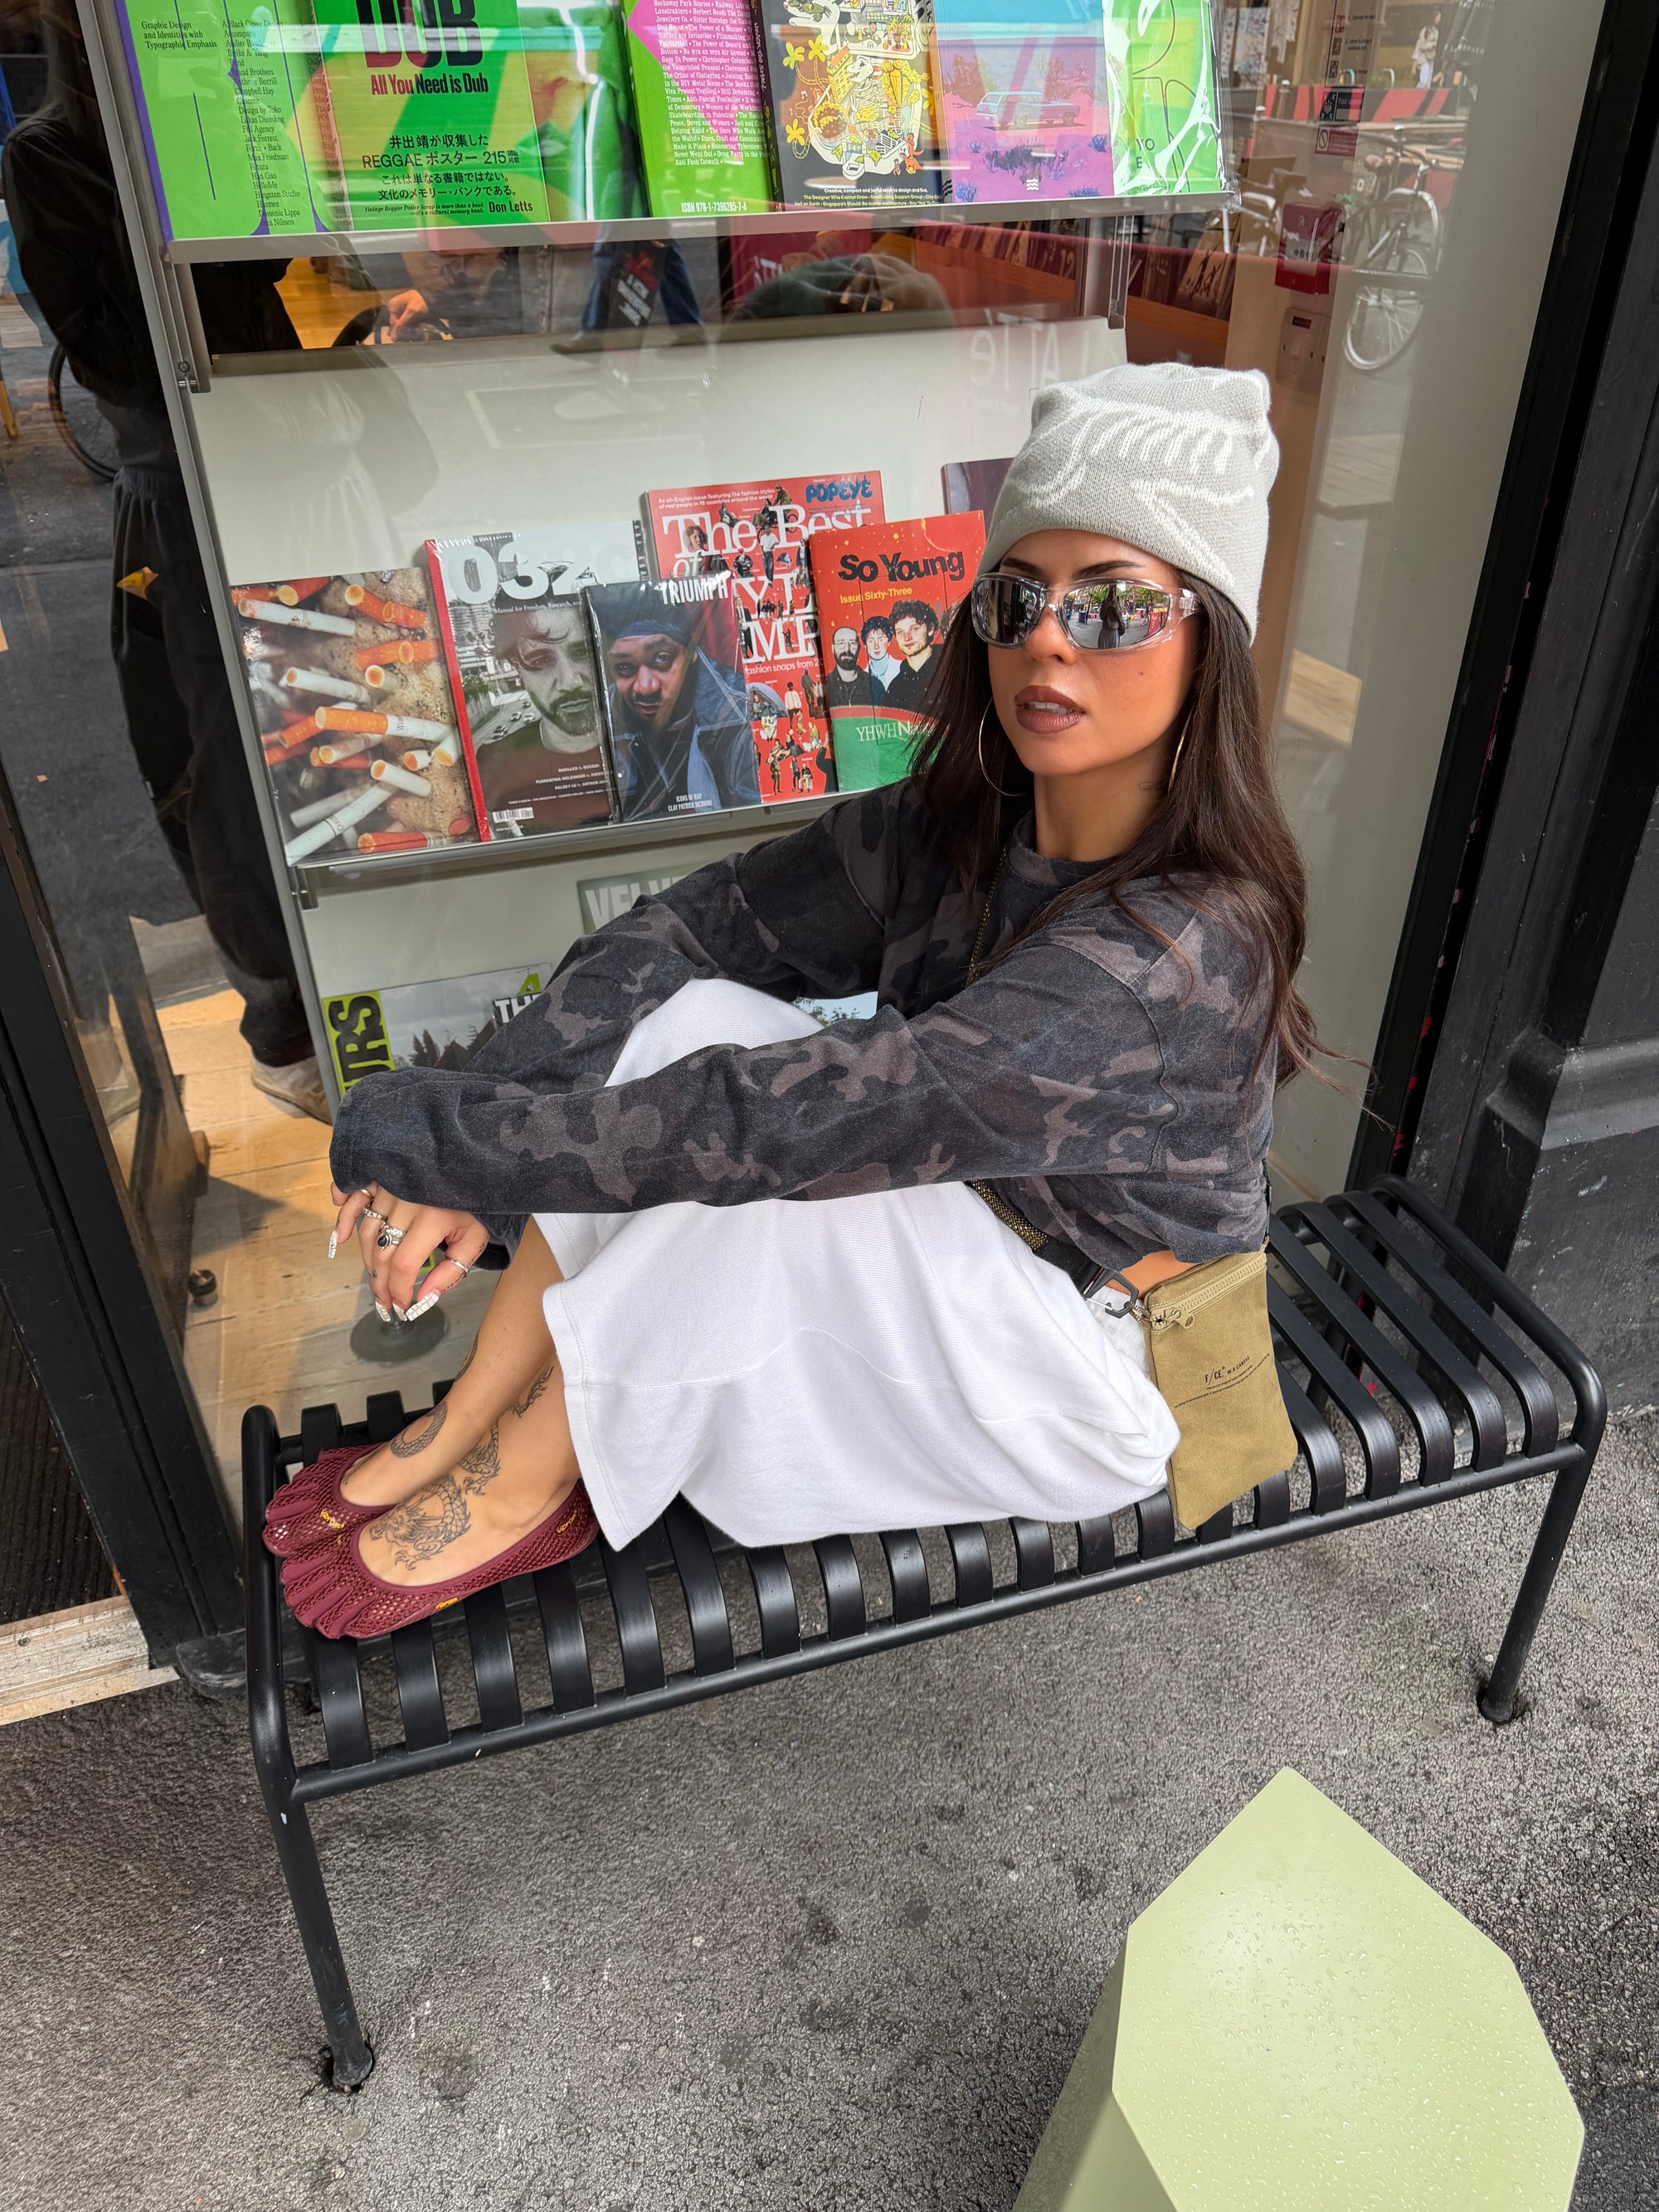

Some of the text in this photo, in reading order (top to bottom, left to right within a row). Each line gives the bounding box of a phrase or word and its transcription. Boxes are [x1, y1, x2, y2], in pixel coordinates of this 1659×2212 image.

[141, 21, 168, 30] Graphic
[187, 40, 217, 49] Emphasis
[371, 72, 489, 95] All You Need is Dub
[262, 88, 275, 96] Hay
[674, 104, 701, 112] Democracy
[255, 125, 275, 134] Agency
[258, 134, 278, 143] Forrest
[362, 151, 508, 168] REGGAE ポスター 215
[282, 190, 300, 198] Studio
[489, 200, 534, 213] Don Letts
[681, 202, 696, 213] ISBN
[284, 209, 300, 218] Lippa
[708, 493, 732, 501] featuring
[741, 489, 760, 498] fashion
[760, 488, 776, 496] styles
[805, 477, 873, 504] POPEYE
[676, 502, 693, 510] people
[661, 511, 758, 558] The
[768, 499, 872, 551] Best
[673, 550, 706, 579] of
[838, 550, 965, 582] So Young
[659, 576, 729, 605] TRIUMPH
[839, 586, 913, 605] Issue Sixty-Three
[494, 605, 515, 615] Manual
[515, 605, 523, 613] for
[523, 602, 547, 612] Freedom,
[773, 664, 796, 673] snaps
[796, 659, 815, 670] from
[855, 722, 898, 742] YHWH
